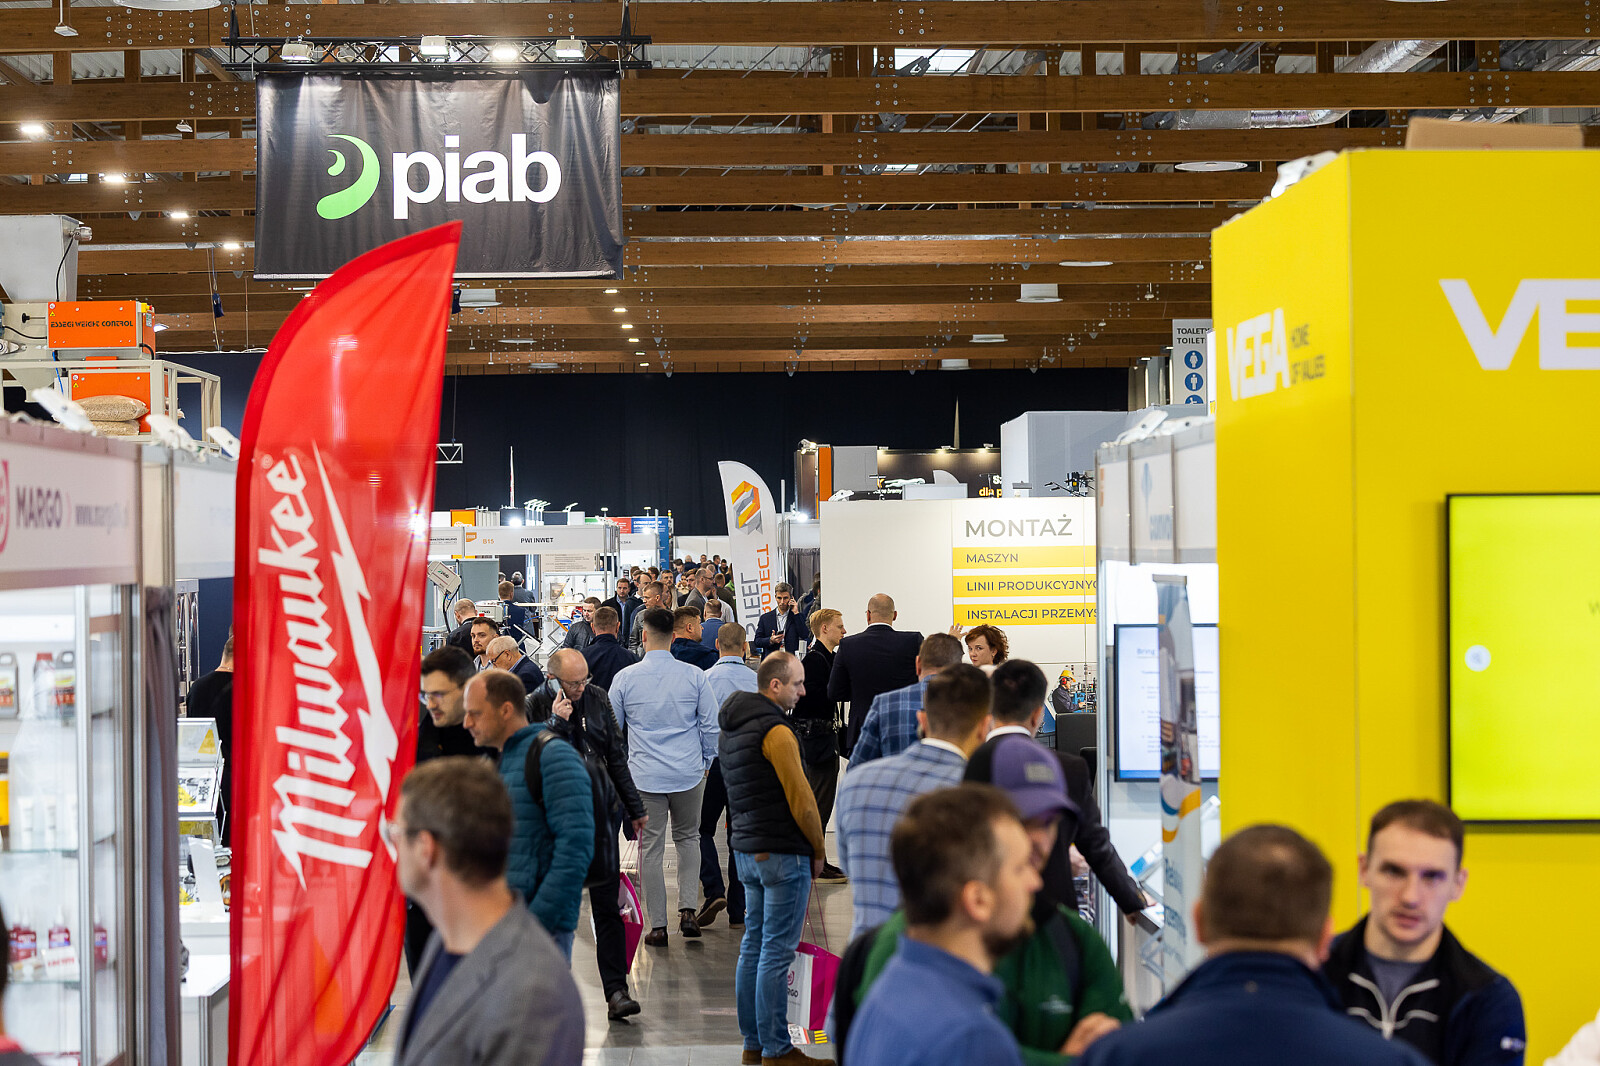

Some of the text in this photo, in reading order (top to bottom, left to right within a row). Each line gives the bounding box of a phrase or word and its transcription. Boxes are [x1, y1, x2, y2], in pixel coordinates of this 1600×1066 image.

[392, 133, 562, 220] piab
[75, 320, 100, 328] WEIGHT
[1225, 307, 1291, 402] VEGA
[15, 485, 63, 529] MARGO
[965, 513, 1073, 538] MONTAŻ
[966, 553, 1019, 563] MASZYN
[967, 581, 994, 591] LINII
[967, 609, 1038, 620] INSTALACJI
[257, 453, 374, 891] Milwaukee
